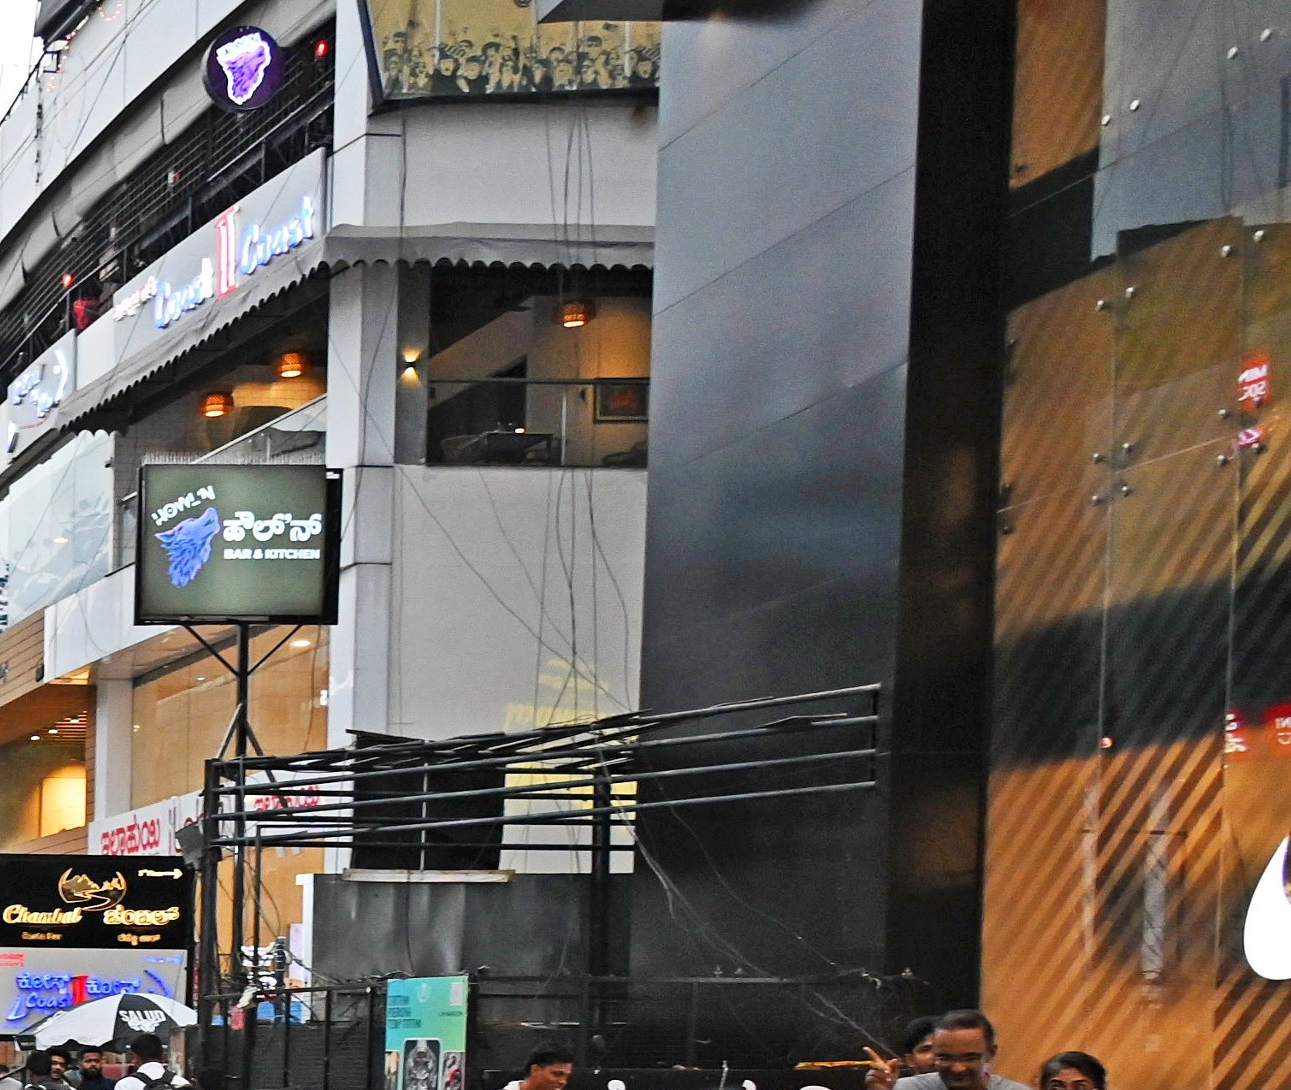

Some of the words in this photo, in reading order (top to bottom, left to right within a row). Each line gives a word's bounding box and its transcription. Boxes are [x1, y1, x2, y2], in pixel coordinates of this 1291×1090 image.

[223, 548, 252, 560] BAR
[264, 548, 321, 560] KITCHEN
[3, 904, 83, 924] Chambal
[118, 1010, 167, 1023] SALUD
